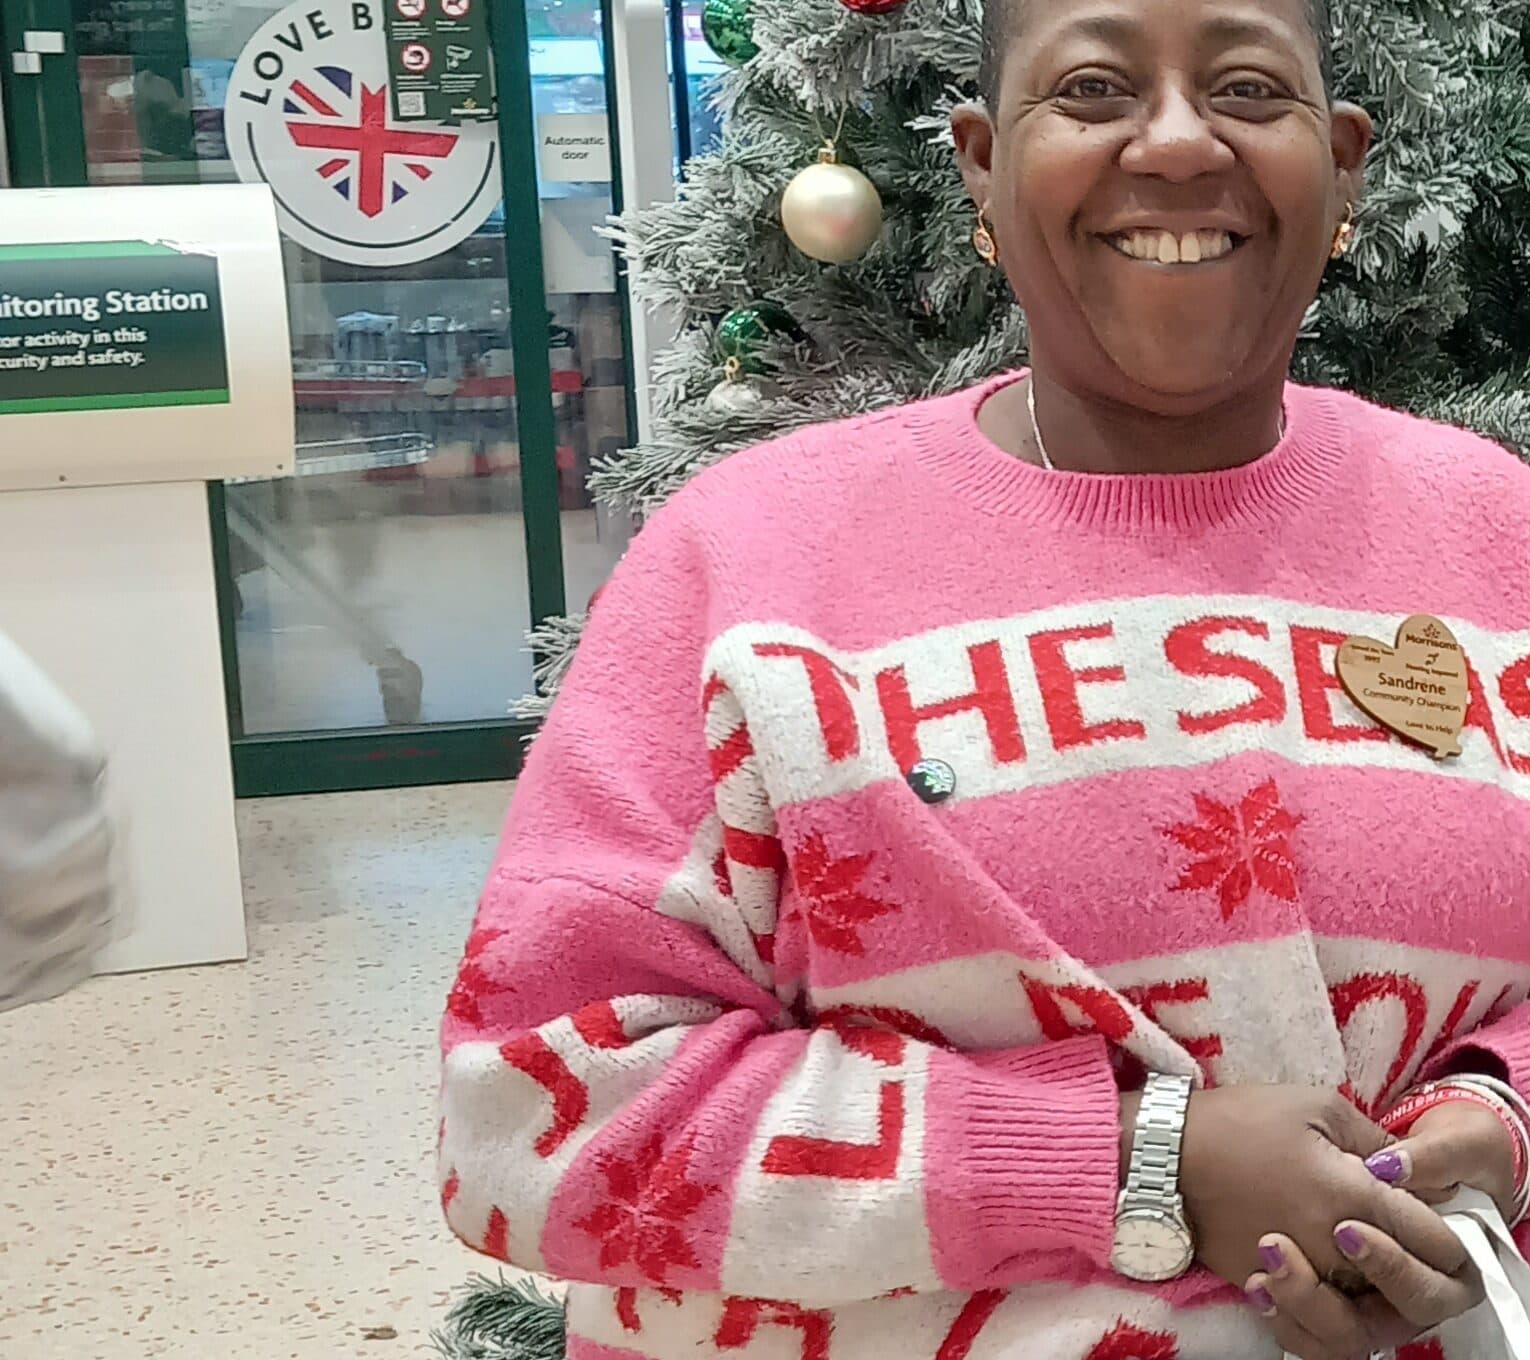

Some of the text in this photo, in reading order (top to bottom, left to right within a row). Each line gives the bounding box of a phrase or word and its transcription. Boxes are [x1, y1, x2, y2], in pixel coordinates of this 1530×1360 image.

[240, 9, 334, 106] LOVE
[544, 135, 606, 146] Automatic
[561, 150, 590, 160] door
[105, 288, 209, 314] Station
[24, 330, 91, 349] activity
[93, 329, 112, 344] in
[113, 327, 147, 344] this
[51, 350, 86, 367] and
[88, 348, 146, 367] safety.
[1406, 633, 1458, 651] Morrisons
[1378, 672, 1446, 696] Sandrene
[1363, 687, 1461, 713] Community Champion
